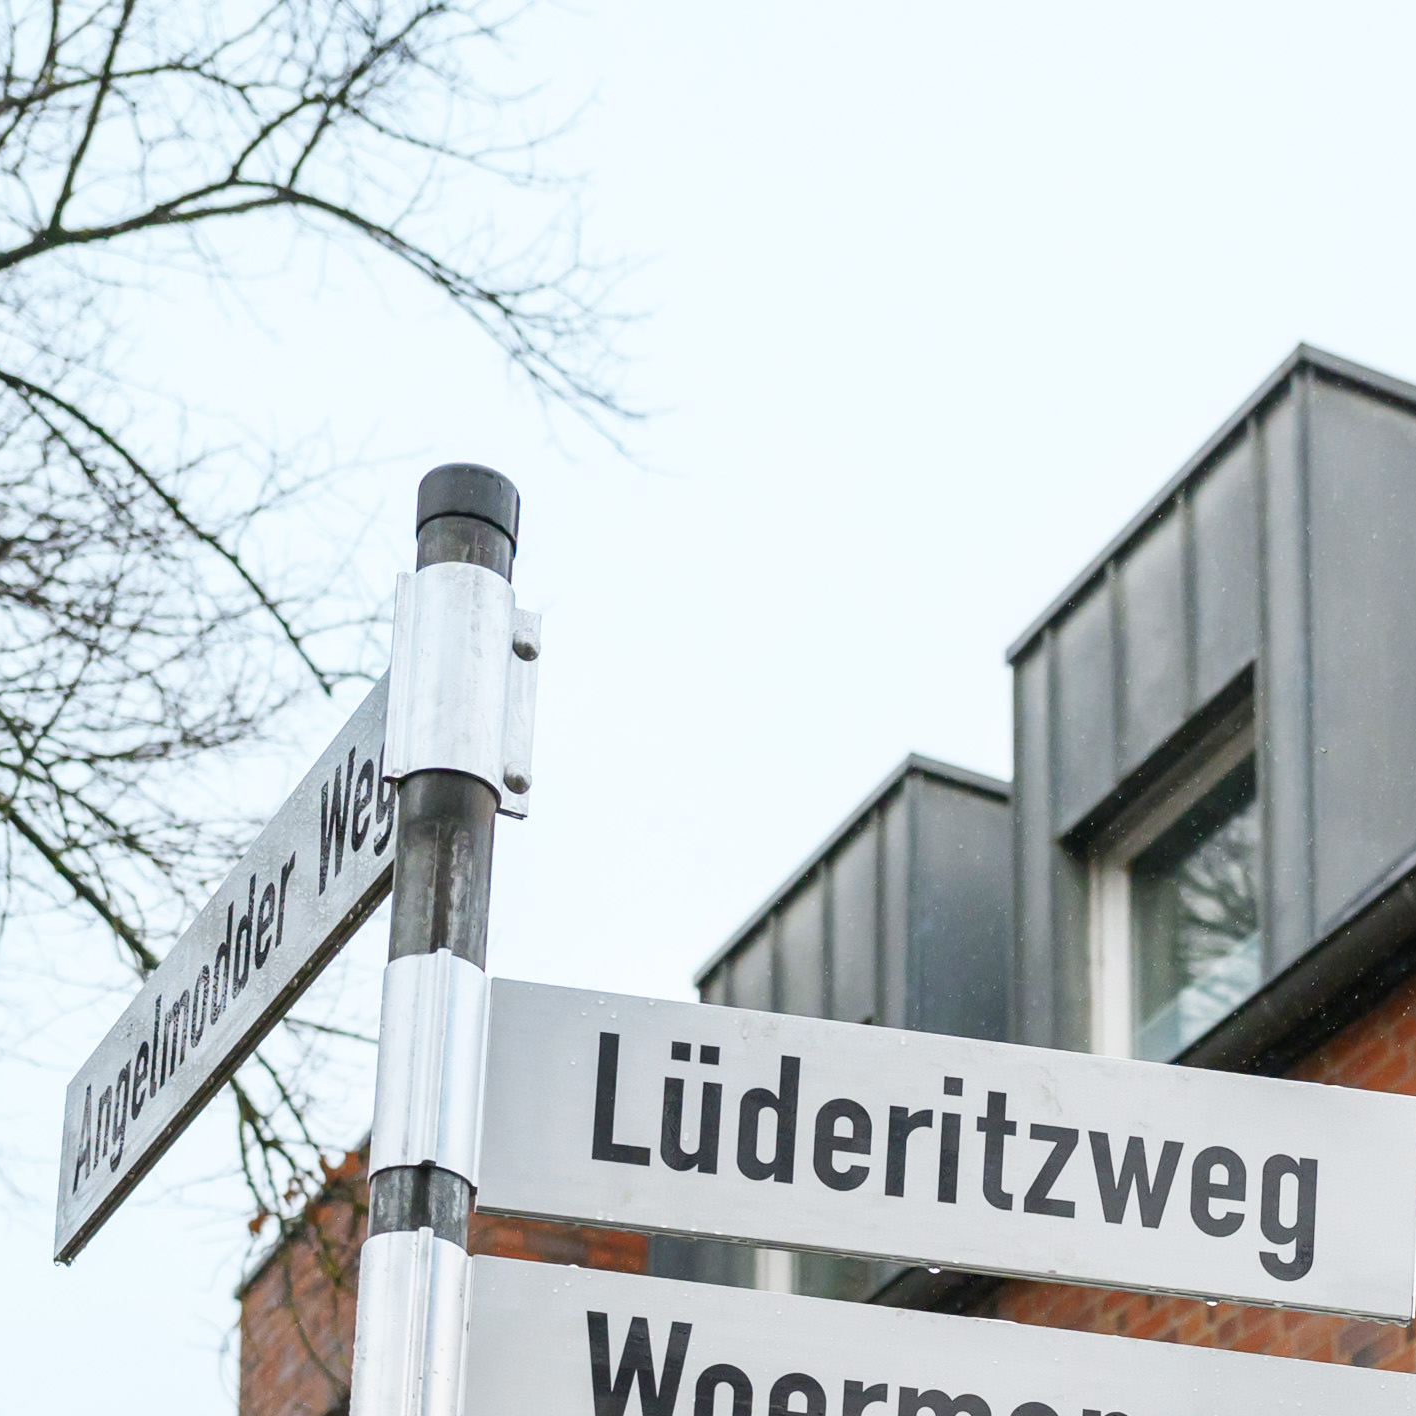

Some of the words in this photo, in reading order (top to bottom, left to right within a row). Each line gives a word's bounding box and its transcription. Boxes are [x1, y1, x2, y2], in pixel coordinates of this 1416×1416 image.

[72, 850, 296, 1196] Angelmodder
[318, 741, 398, 895] Weg
[591, 1031, 1320, 1282] Lüderitzweg
